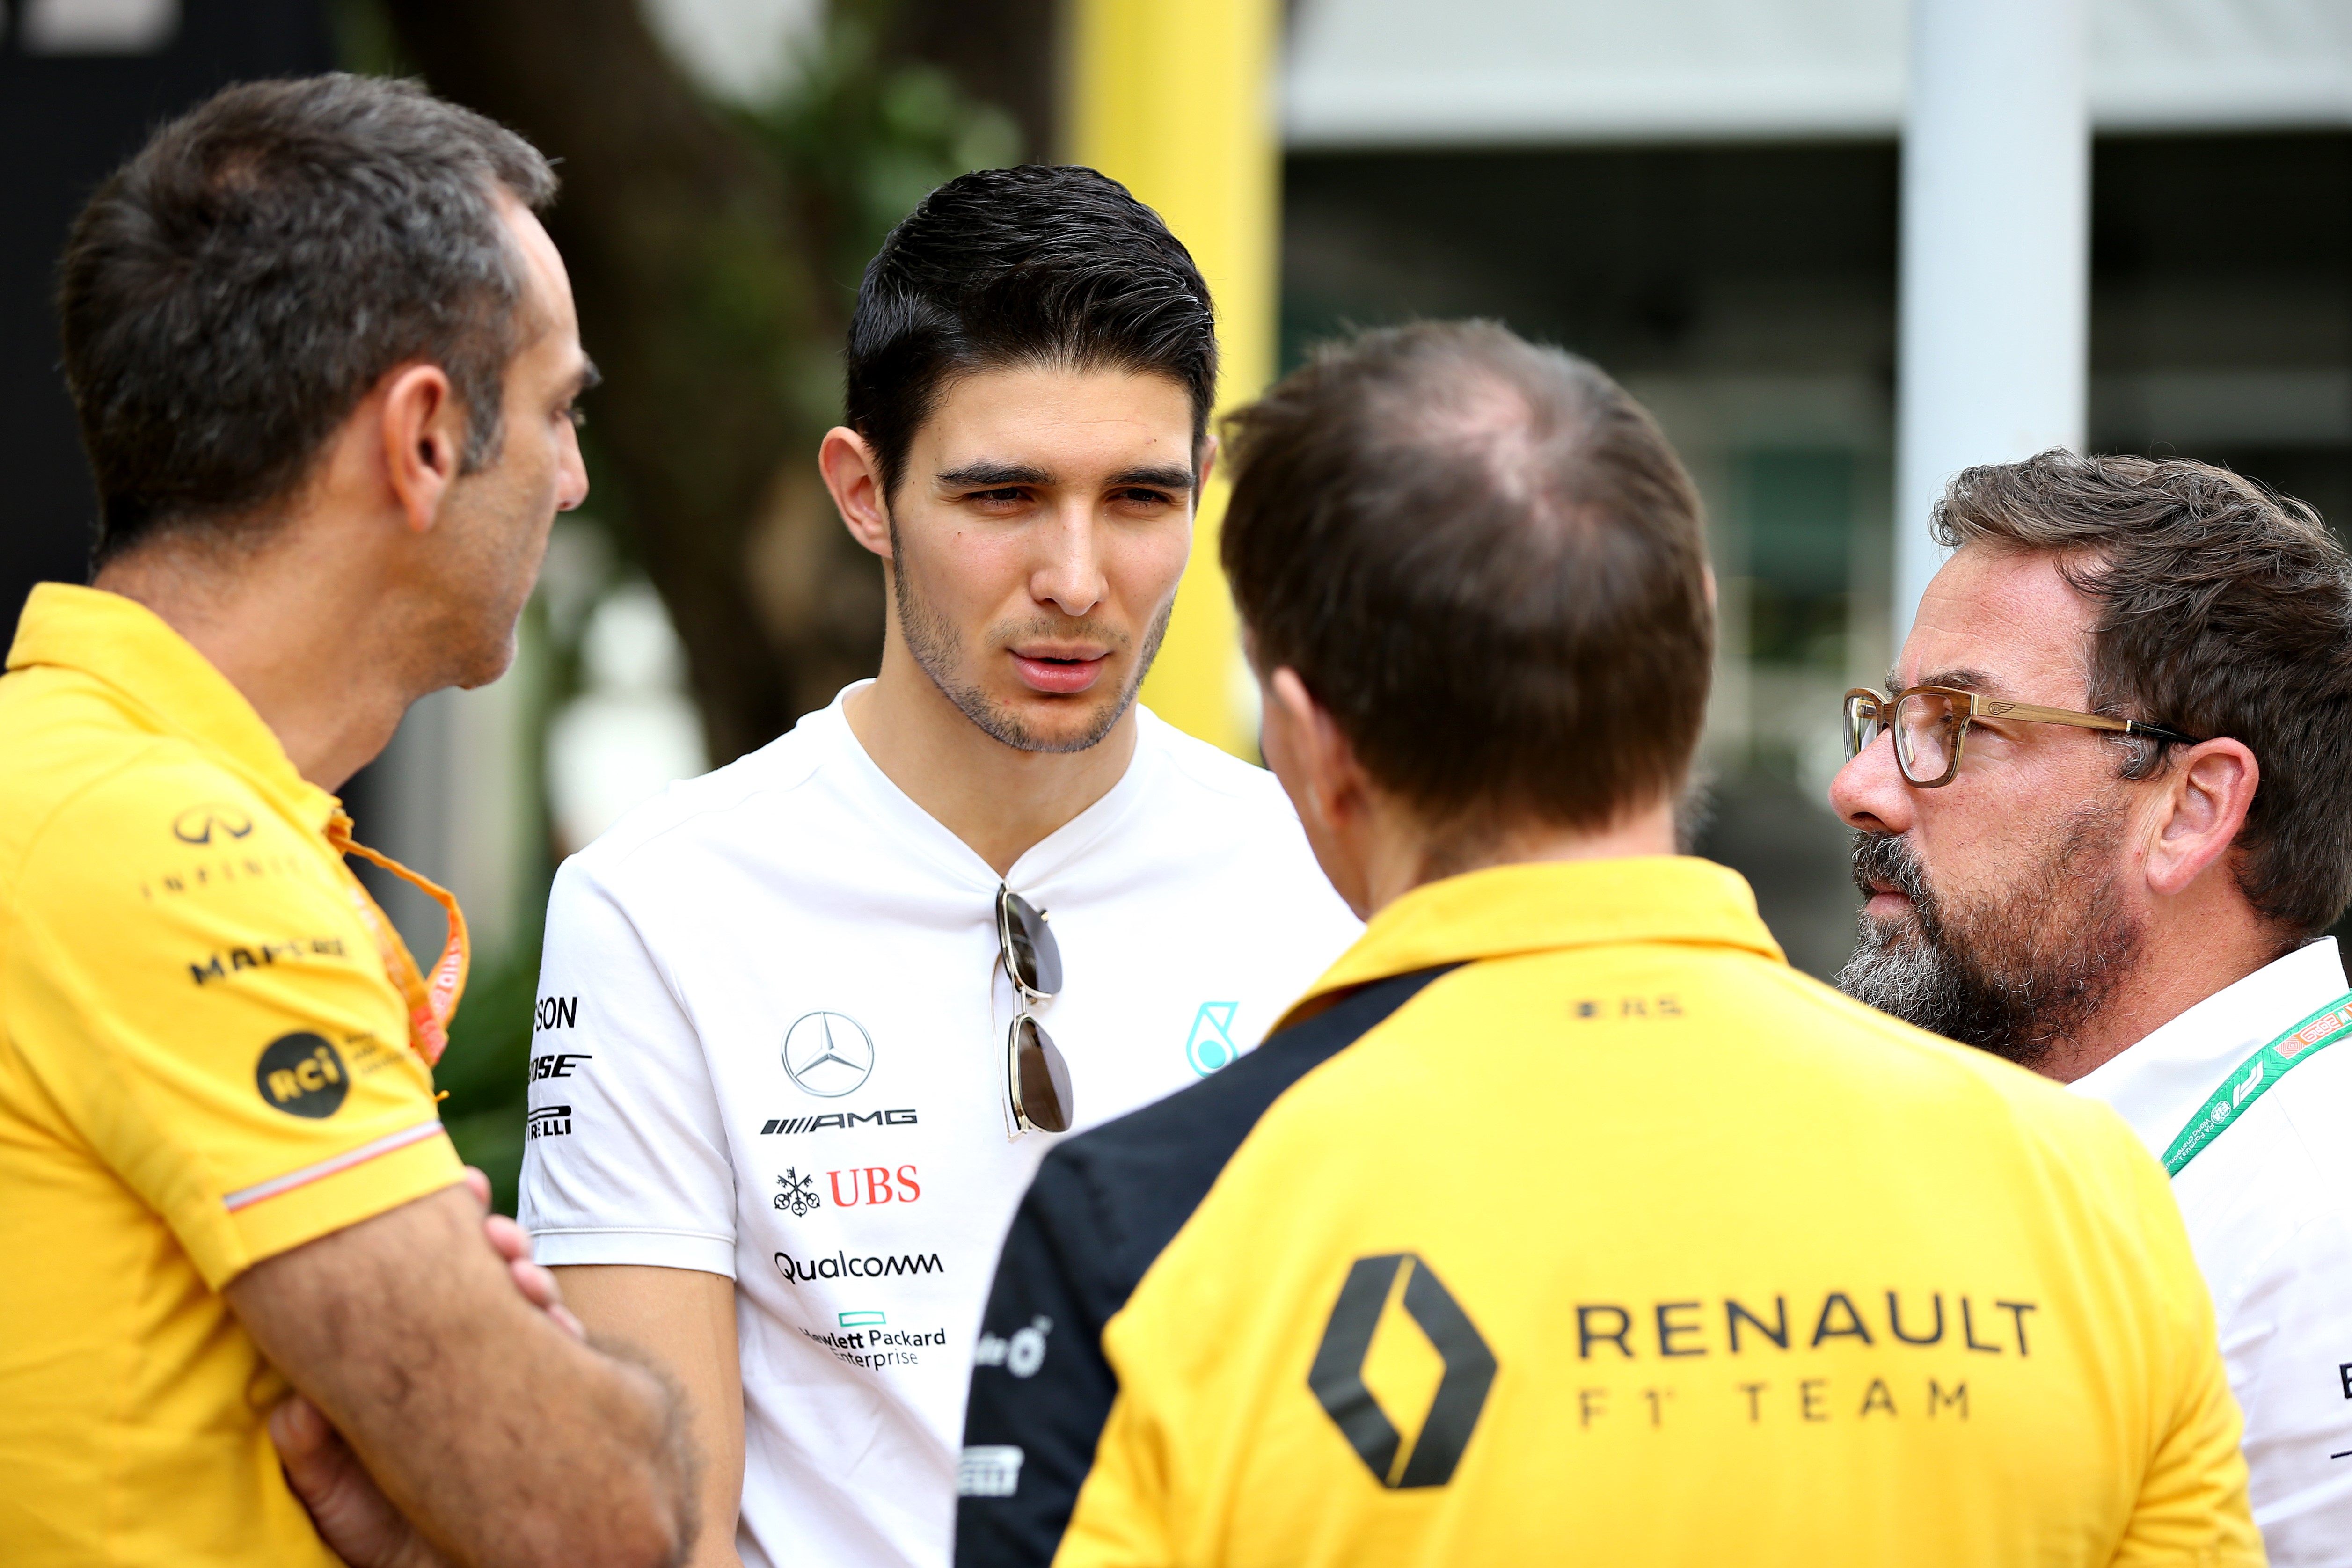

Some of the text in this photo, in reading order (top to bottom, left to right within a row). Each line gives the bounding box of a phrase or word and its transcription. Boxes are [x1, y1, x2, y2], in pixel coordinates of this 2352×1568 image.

[535, 996, 577, 1032] SON
[529, 1055, 592, 1082] OSE
[826, 1165, 920, 1207] UBS
[774, 1250, 944, 1284] Qualcomm
[869, 1327, 946, 1346] Packard
[1573, 1290, 2039, 1359] RENAULT
[829, 1347, 918, 1371] Enterprise
[1738, 1377, 1971, 1423] TEAM
